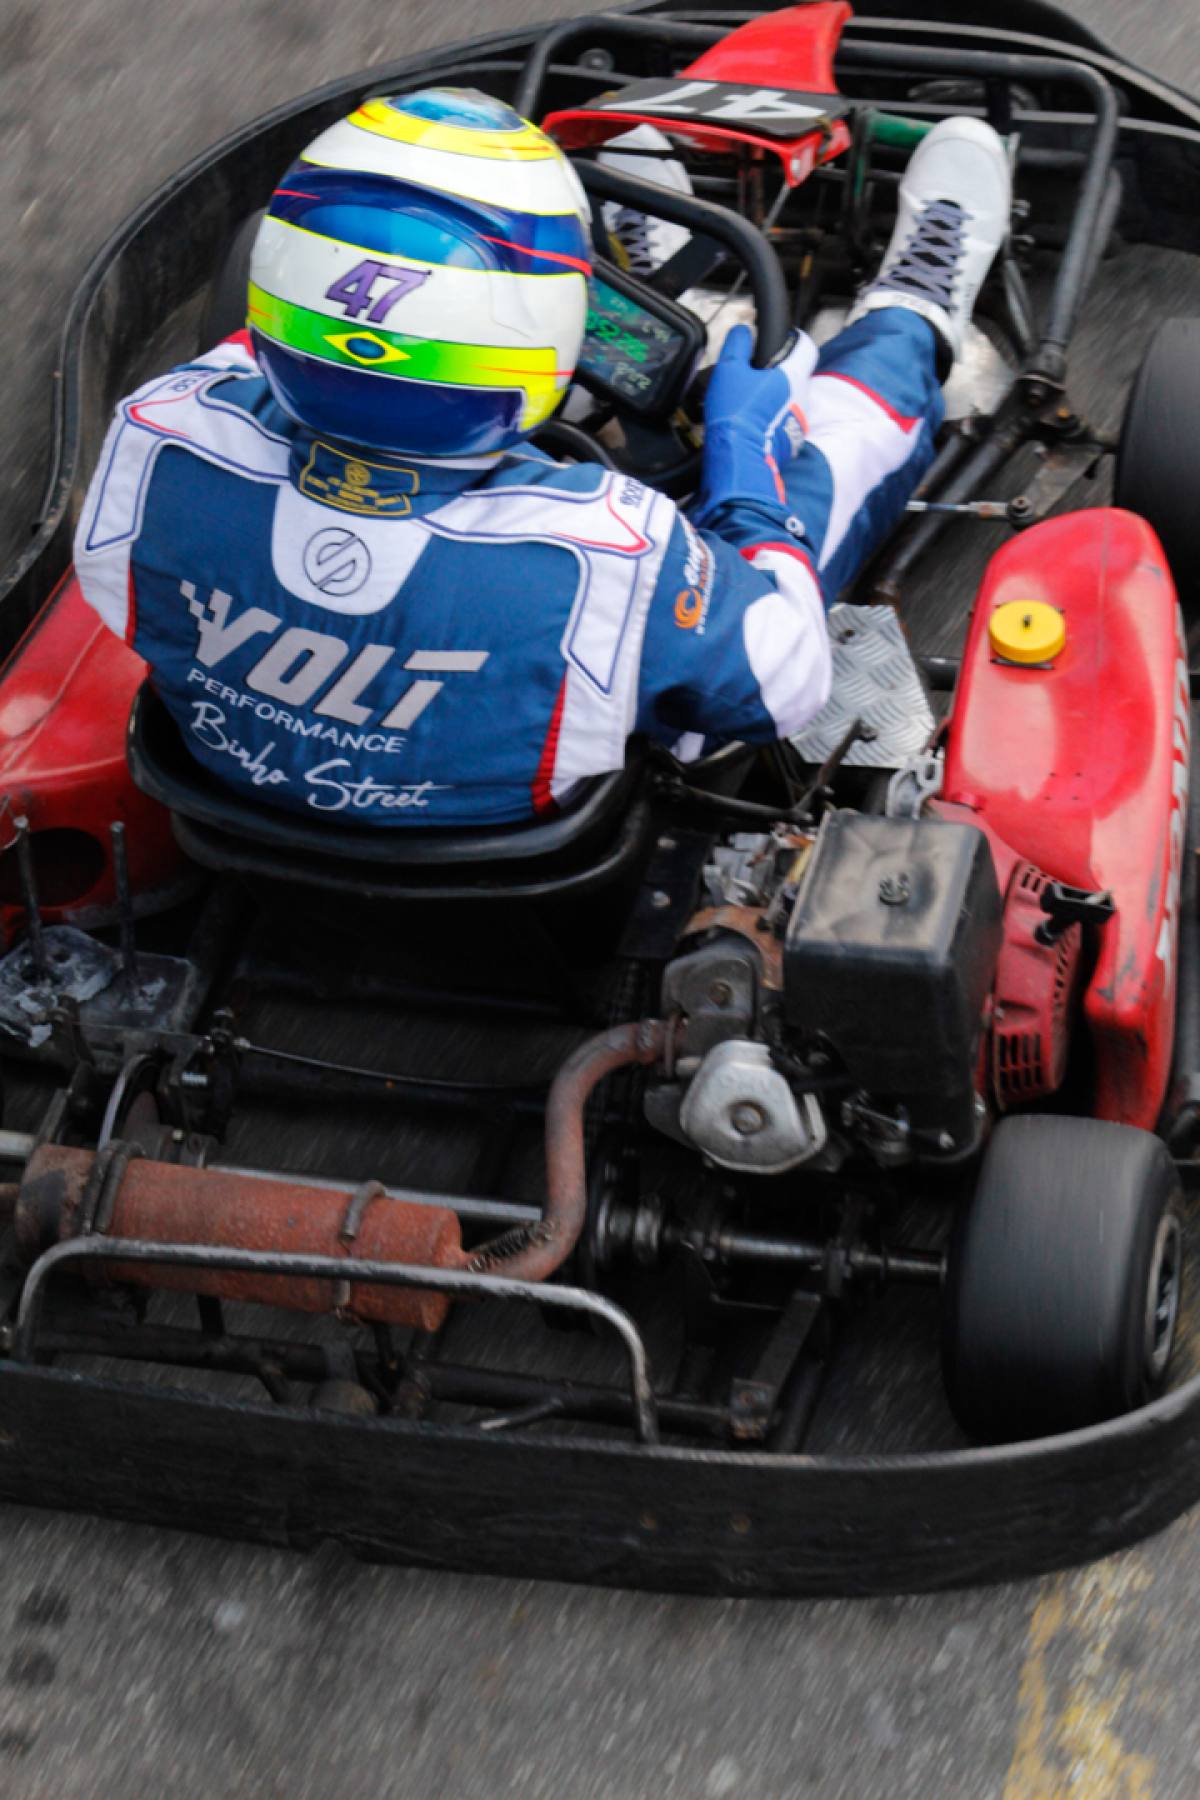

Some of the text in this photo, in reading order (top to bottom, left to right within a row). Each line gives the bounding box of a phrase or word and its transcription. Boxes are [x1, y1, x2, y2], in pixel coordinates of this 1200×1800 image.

[600, 82, 827, 119] 47
[325, 259, 432, 324] 47
[180, 580, 490, 730] VOLT
[187, 667, 407, 753] PERFORMANCE
[303, 758, 454, 811] Street
